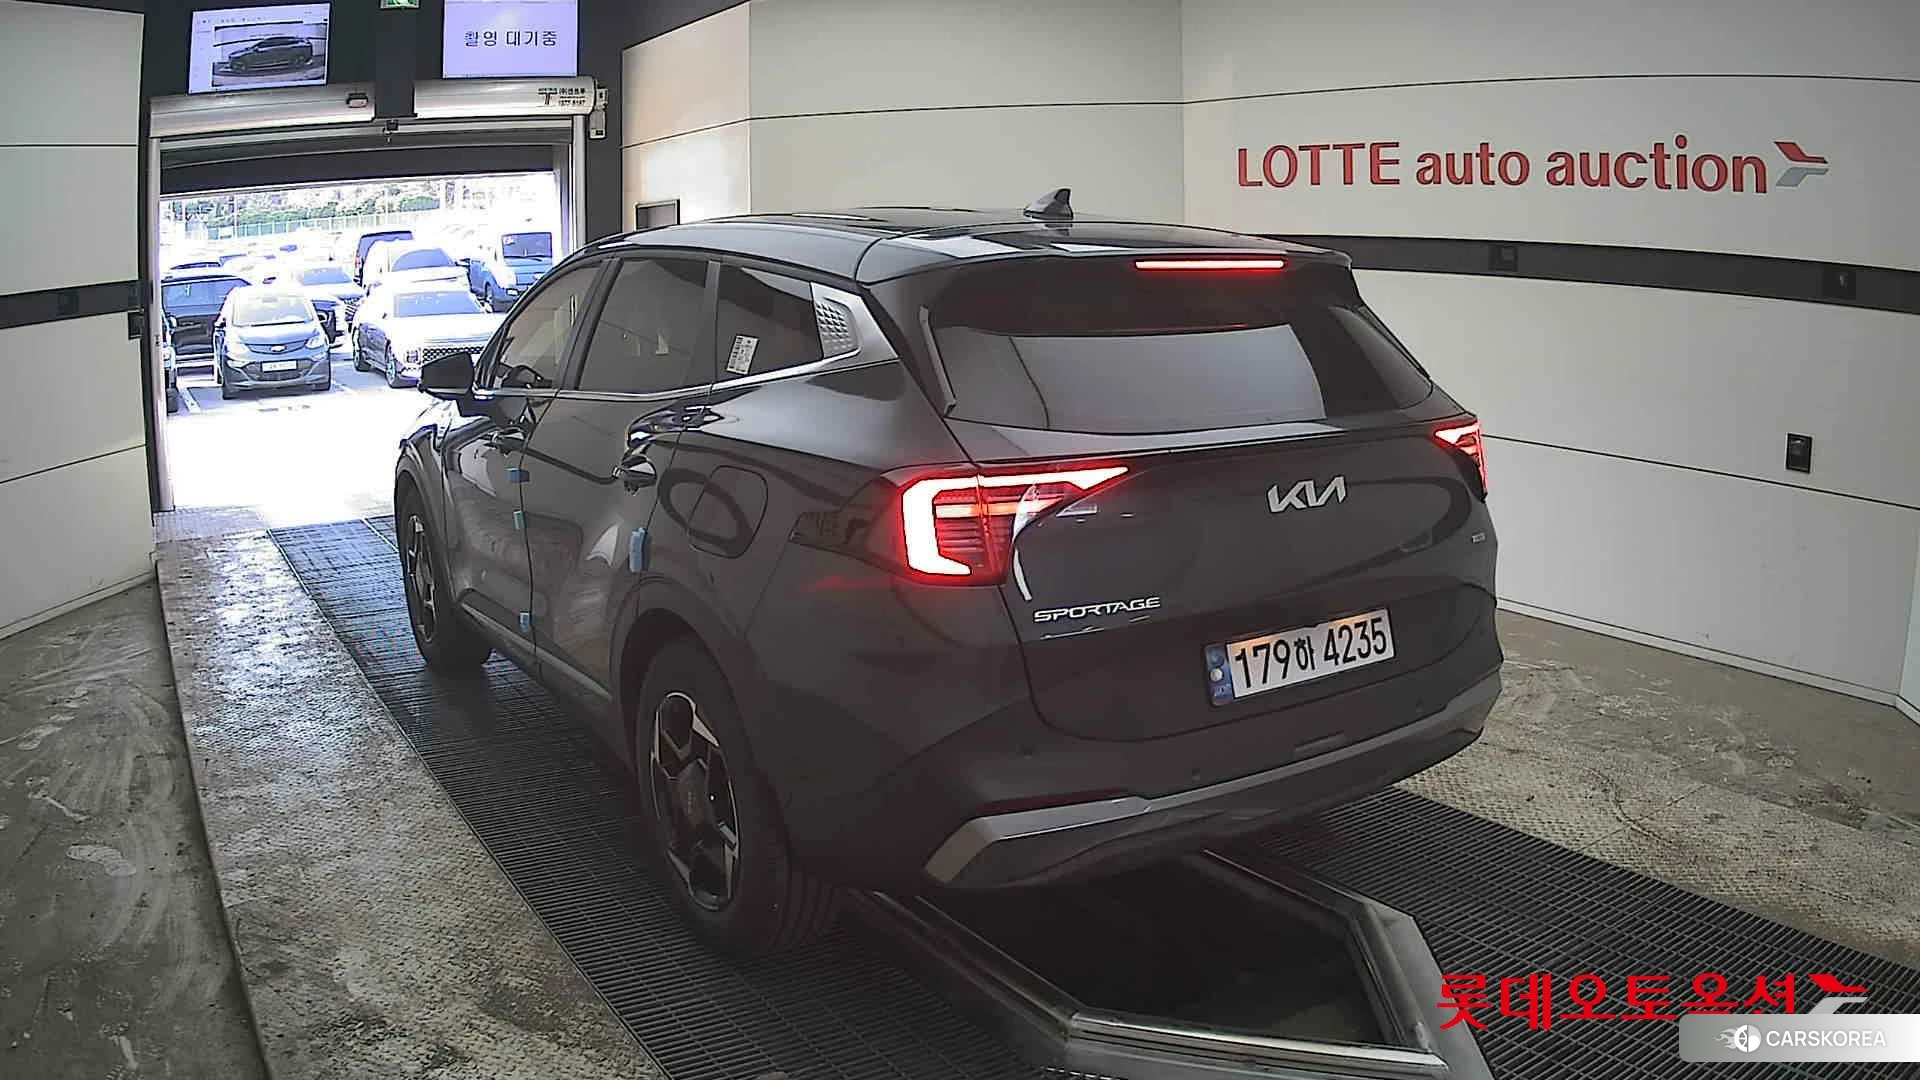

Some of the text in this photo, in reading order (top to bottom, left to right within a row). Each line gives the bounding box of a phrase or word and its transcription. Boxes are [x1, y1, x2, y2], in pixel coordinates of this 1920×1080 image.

[506, 30, 558, 47] 대기중
[1238, 135, 1767, 193] LOTTE auto auction
[1266, 475, 1348, 513] KIA
[1034, 596, 1161, 622] SPORTAGE
[1234, 617, 1388, 689] 179하 4235
